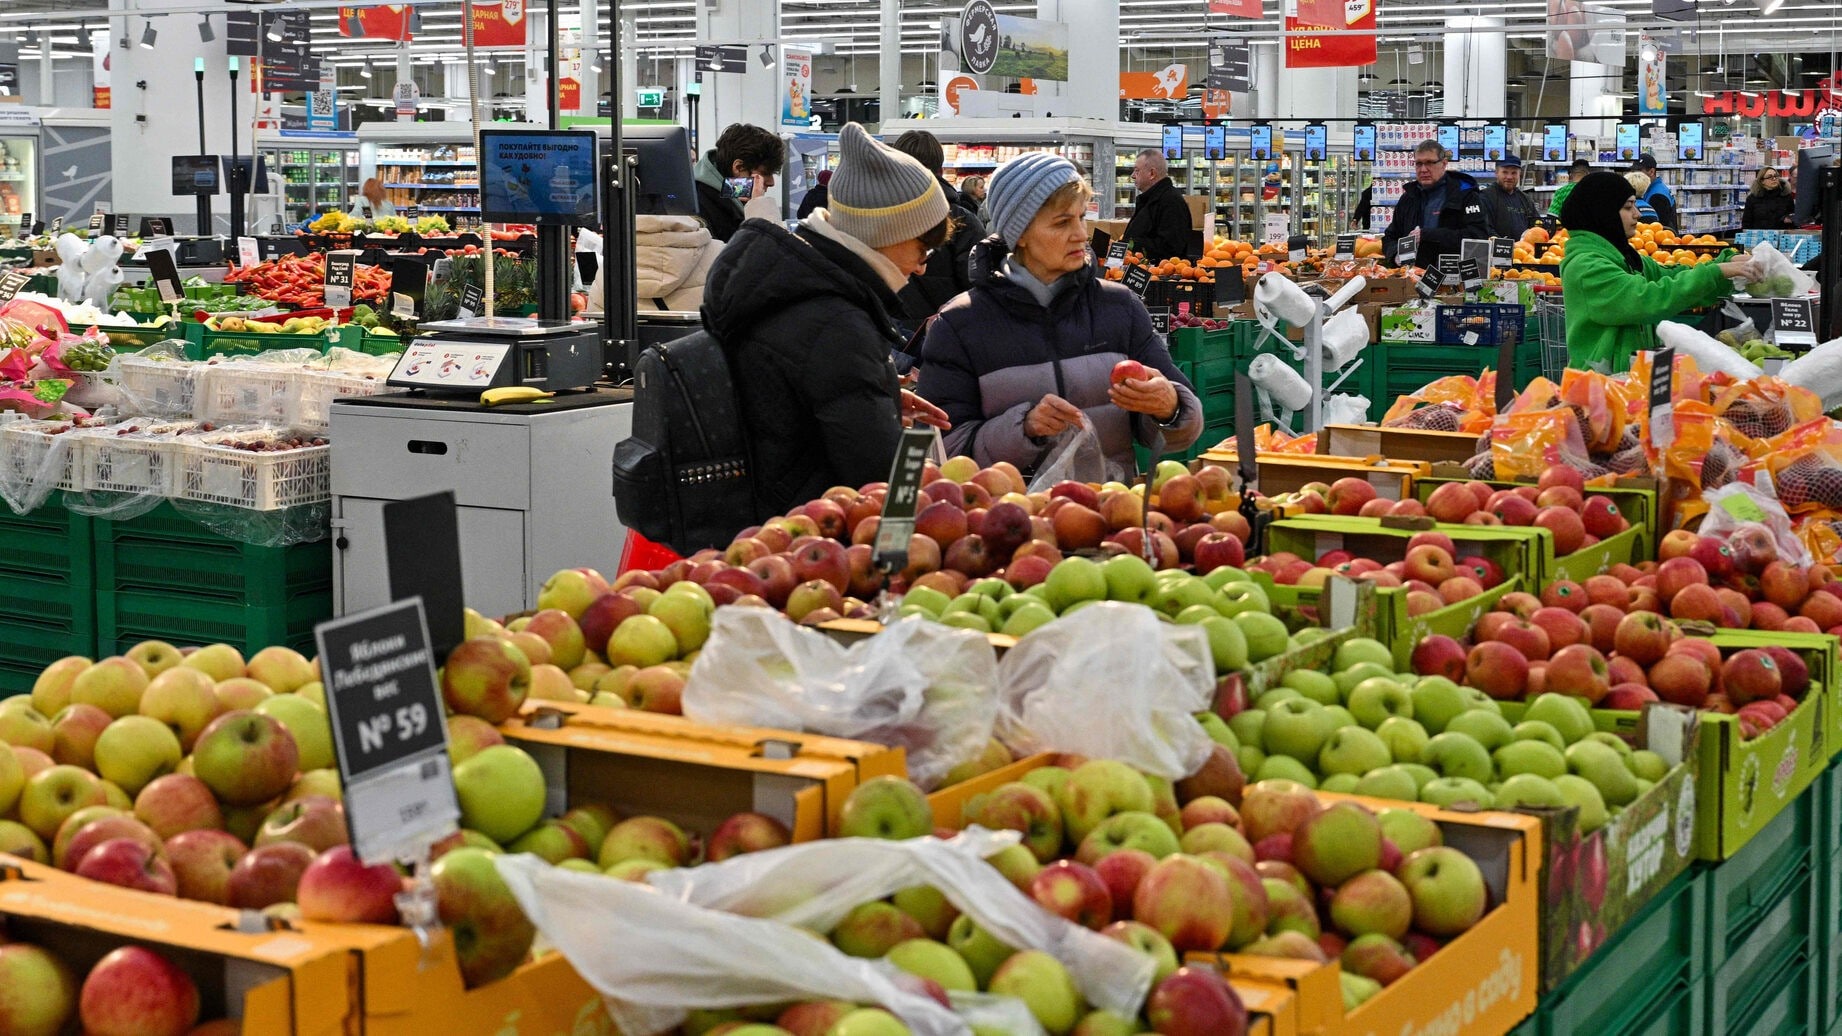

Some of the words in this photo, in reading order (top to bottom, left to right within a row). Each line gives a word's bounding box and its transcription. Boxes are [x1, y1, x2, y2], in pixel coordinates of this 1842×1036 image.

[965, 5, 997, 31] ФЕРМЕРСКАЯ
[1290, 39, 1321, 51] ЦЕНА
[971, 57, 990, 69] ЛАВКА
[498, 142, 541, 151] ПОКУПАЙТЕ
[542, 143, 579, 152] ВЫГОДНО
[499, 152, 515, 160] КАК
[515, 152, 547, 161] УДОБНО!
[1465, 204, 1481, 215] HH
[340, 275, 349, 284] 31
[1134, 281, 1143, 289] 89
[1780, 318, 1794, 327] №
[1794, 319, 1807, 328] 22
[356, 711, 393, 754] №
[395, 701, 429, 742] 59
